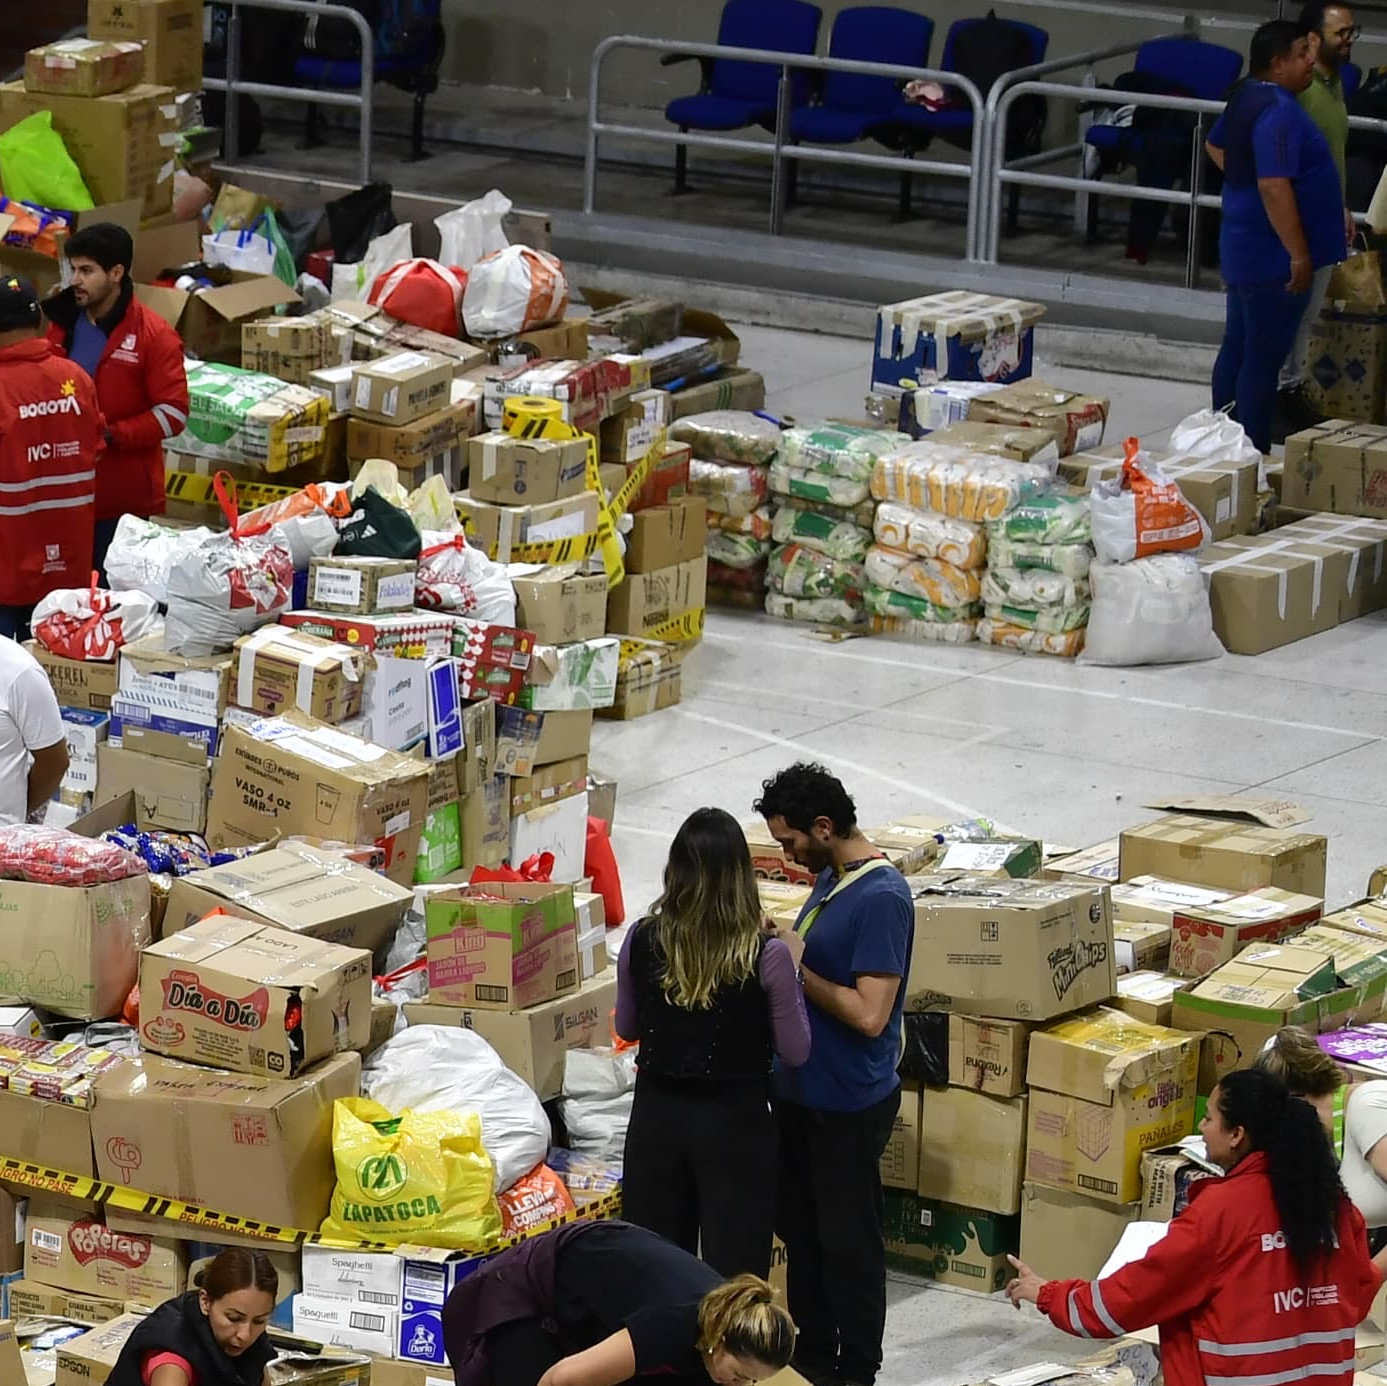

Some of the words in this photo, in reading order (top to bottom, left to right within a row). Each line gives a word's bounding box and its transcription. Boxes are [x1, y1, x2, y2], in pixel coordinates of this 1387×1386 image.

[28, 443, 52, 463] IVC
[235, 777, 265, 799] VASO
[265, 788, 276, 803] 4
[276, 796, 292, 811] OZ
[168, 982, 204, 1010] Día
[206, 999, 222, 1016] a
[223, 1002, 259, 1029] Día
[964, 1055, 1000, 1077] Rexona
[1147, 1085, 1184, 1110] angels
[1138, 1120, 1184, 1147] PAÑALES
[28, 1174, 44, 1188] NO
[45, 1178, 75, 1196] PASE
[1273, 1286, 1304, 1314] IVC
[298, 1306, 339, 1322] Spaguetti
[58, 1357, 90, 1377] EPSON
